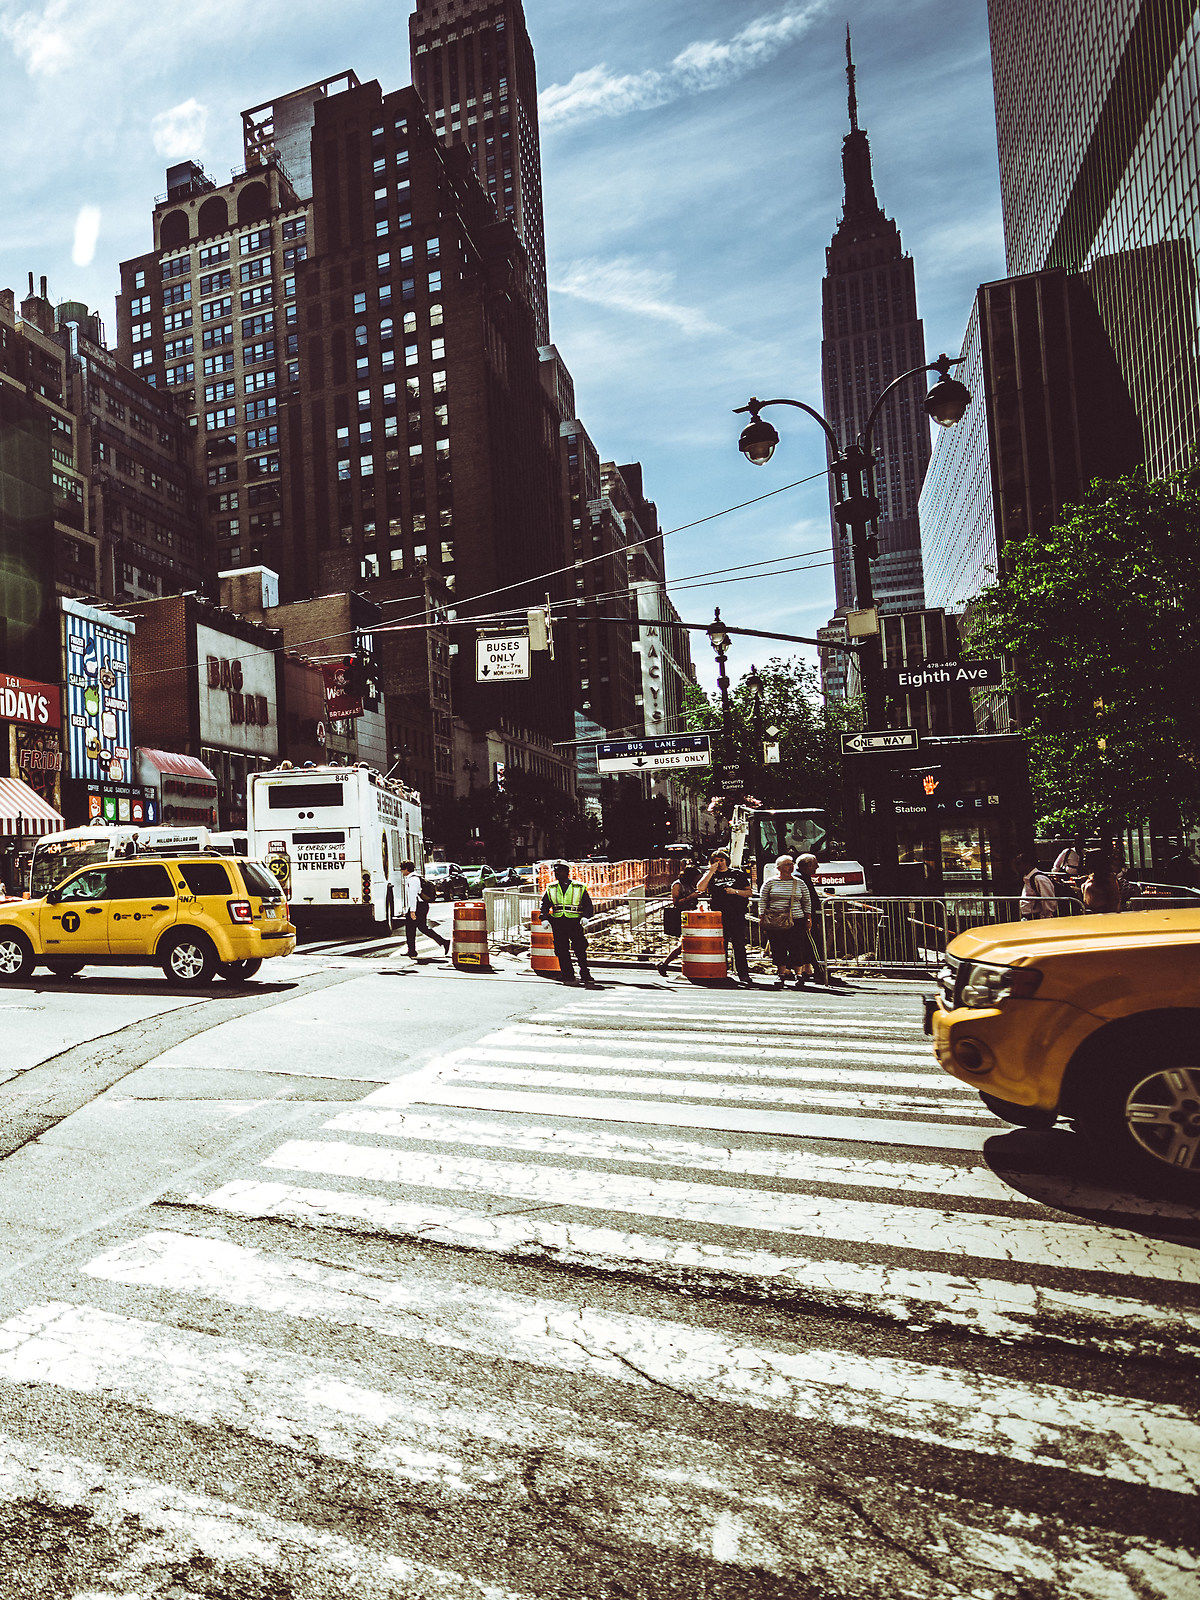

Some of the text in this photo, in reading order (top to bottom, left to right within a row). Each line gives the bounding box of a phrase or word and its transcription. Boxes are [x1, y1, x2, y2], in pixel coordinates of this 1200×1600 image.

[486, 642, 520, 652] BUSES
[490, 653, 516, 662] ONLY
[5, 676, 22, 690] T.G.I.
[899, 668, 988, 688] Eighth Ave
[654, 740, 677, 748] LANE
[853, 736, 906, 748] ONE WAY
[654, 754, 705, 765] BUSES ONLY
[335, 774, 349, 782] 846
[955, 800, 964, 808] C
[974, 799, 982, 807] E
[297, 852, 338, 861] VOTED #1
[297, 861, 346, 871] IN ENERGY
[821, 876, 846, 884] Bobcat
[66, 915, 76, 930] T
